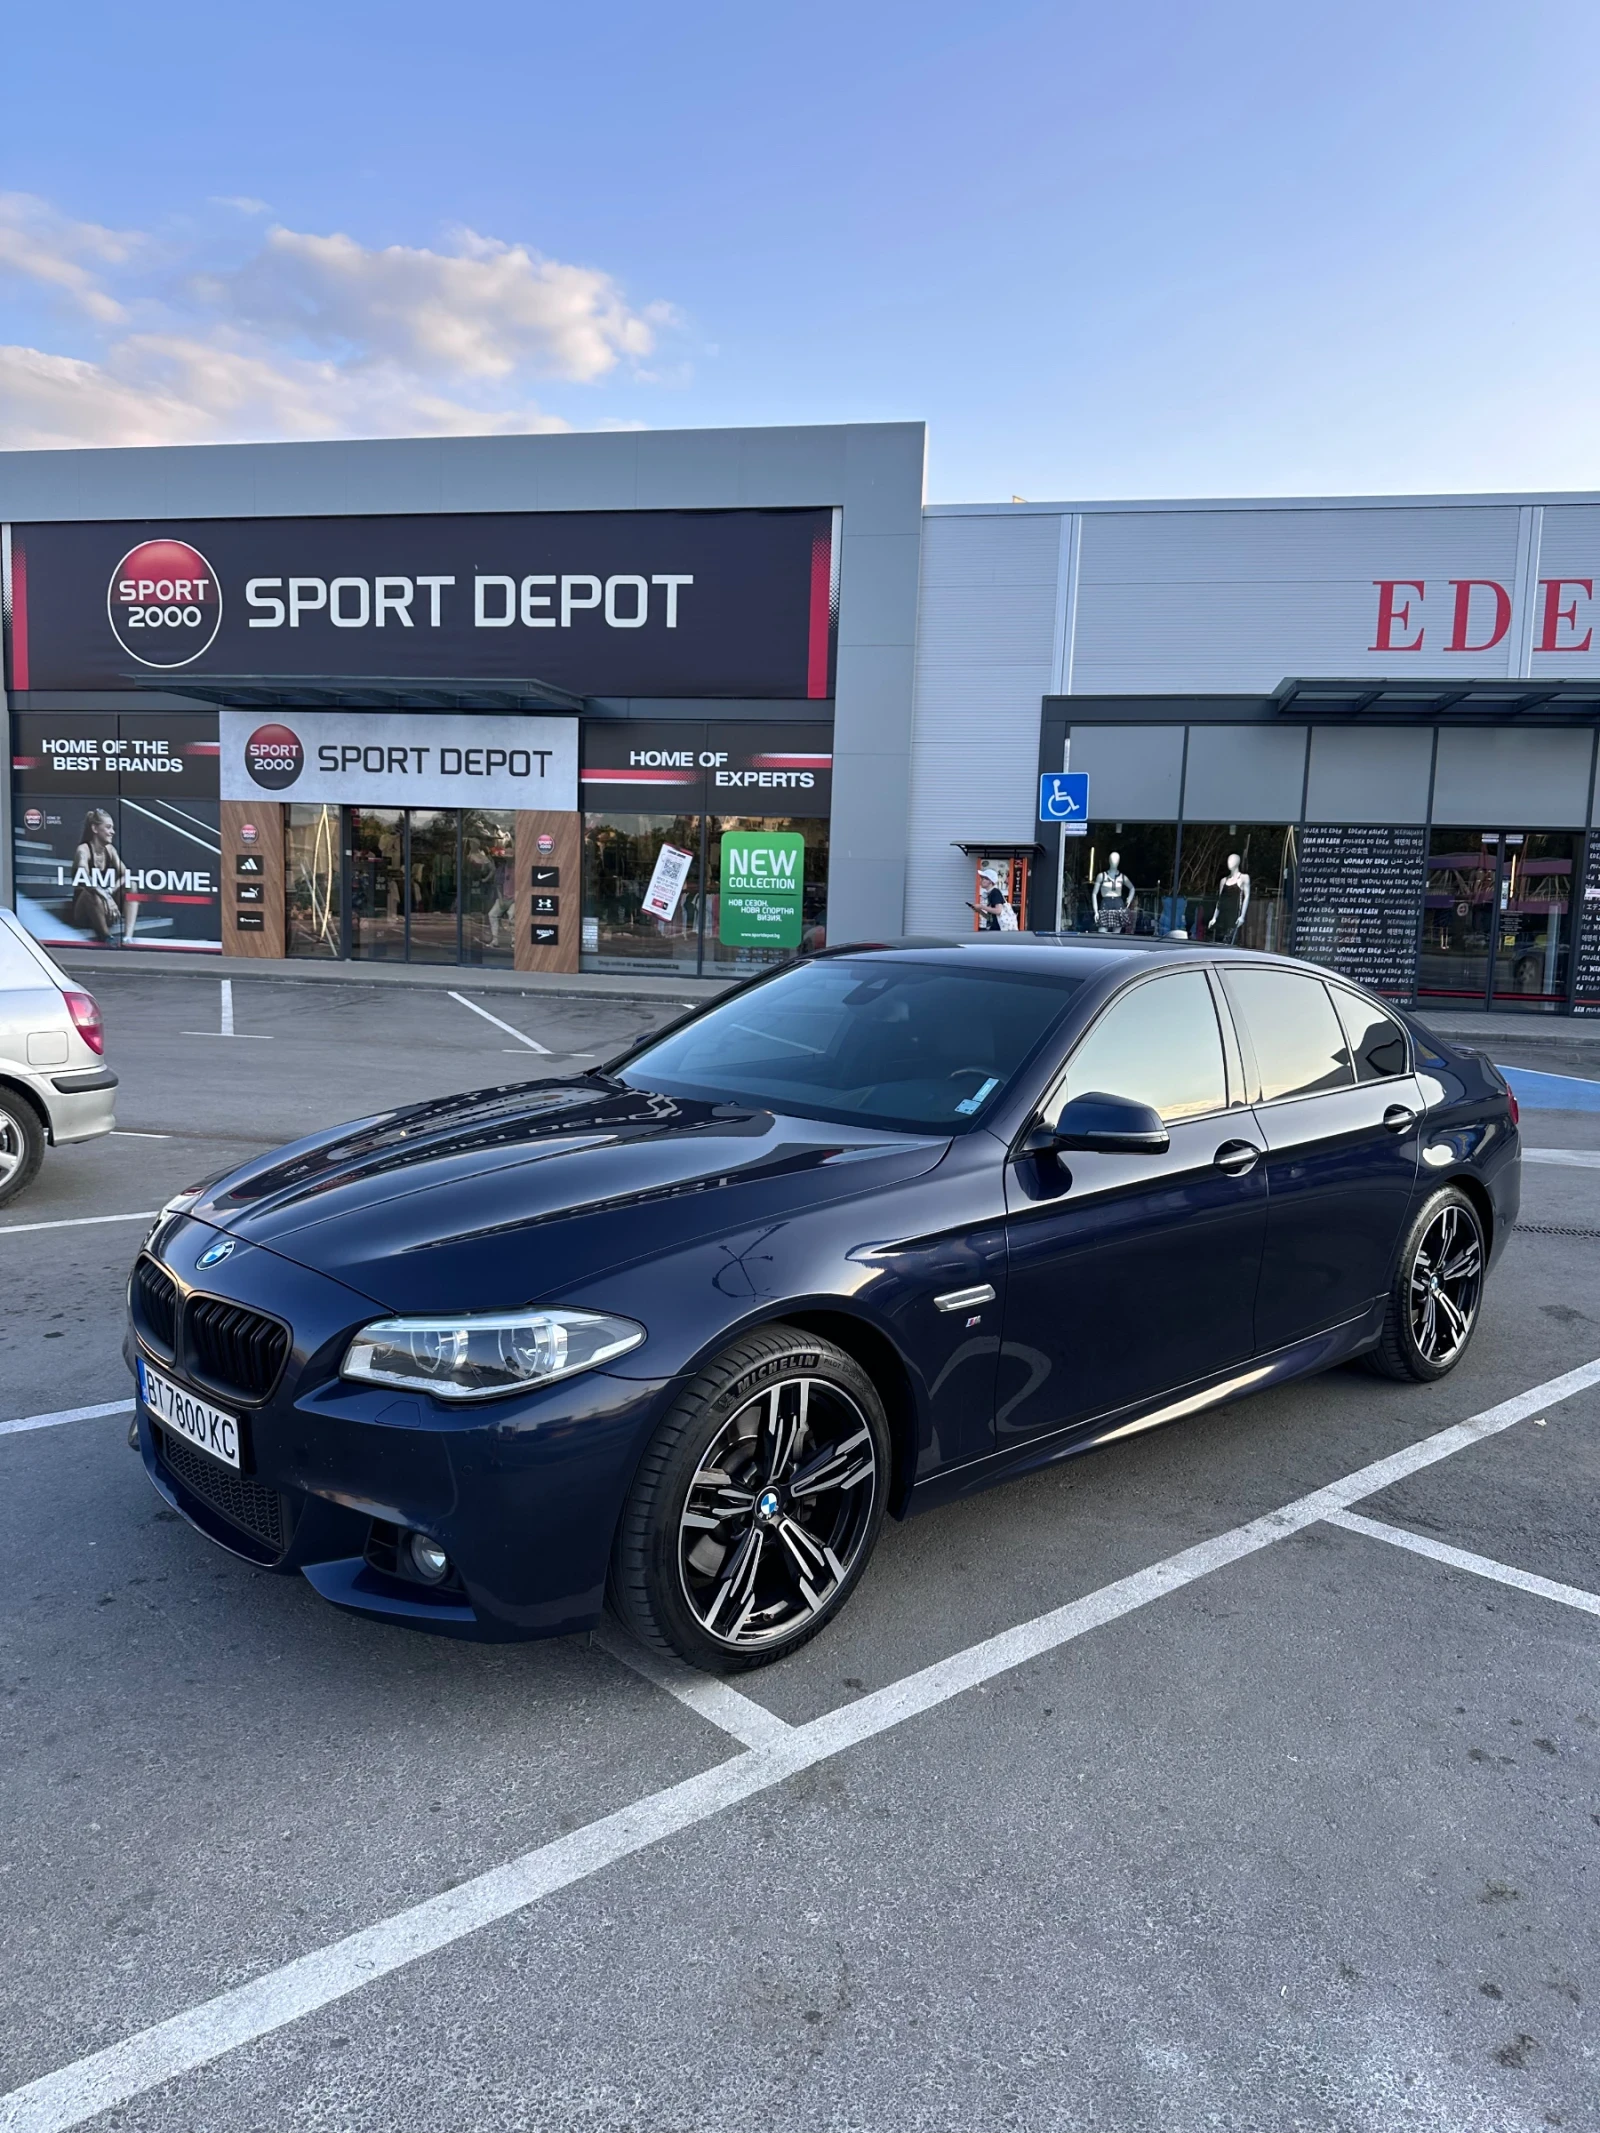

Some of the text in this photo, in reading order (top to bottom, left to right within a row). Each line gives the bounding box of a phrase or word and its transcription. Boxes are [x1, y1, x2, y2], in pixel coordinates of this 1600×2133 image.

[119, 579, 209, 601] SPORT
[245, 574, 694, 628] SPORT DEPOT
[128, 605, 202, 627] 2000
[42, 739, 169, 755] HOME OF THE
[250, 744, 299, 757] SPORT
[53, 756, 183, 773] BEST BRANDS
[253, 758, 295, 770] 2000
[318, 745, 553, 777] SPORT DEPOT
[630, 750, 728, 767] HOME OF
[715, 771, 815, 788] EXPERTS
[729, 848, 797, 876] NEW
[57, 866, 218, 892] I AM HOME.
[729, 877, 795, 889] COLLECTION
[741, 906, 794, 915] НОВА СПОРТНА
[744, 899, 769, 907] СЕЗОН.
[756, 914, 782, 922] ВИЗИЯ.
[737, 1355, 816, 1394] MICHELIN
